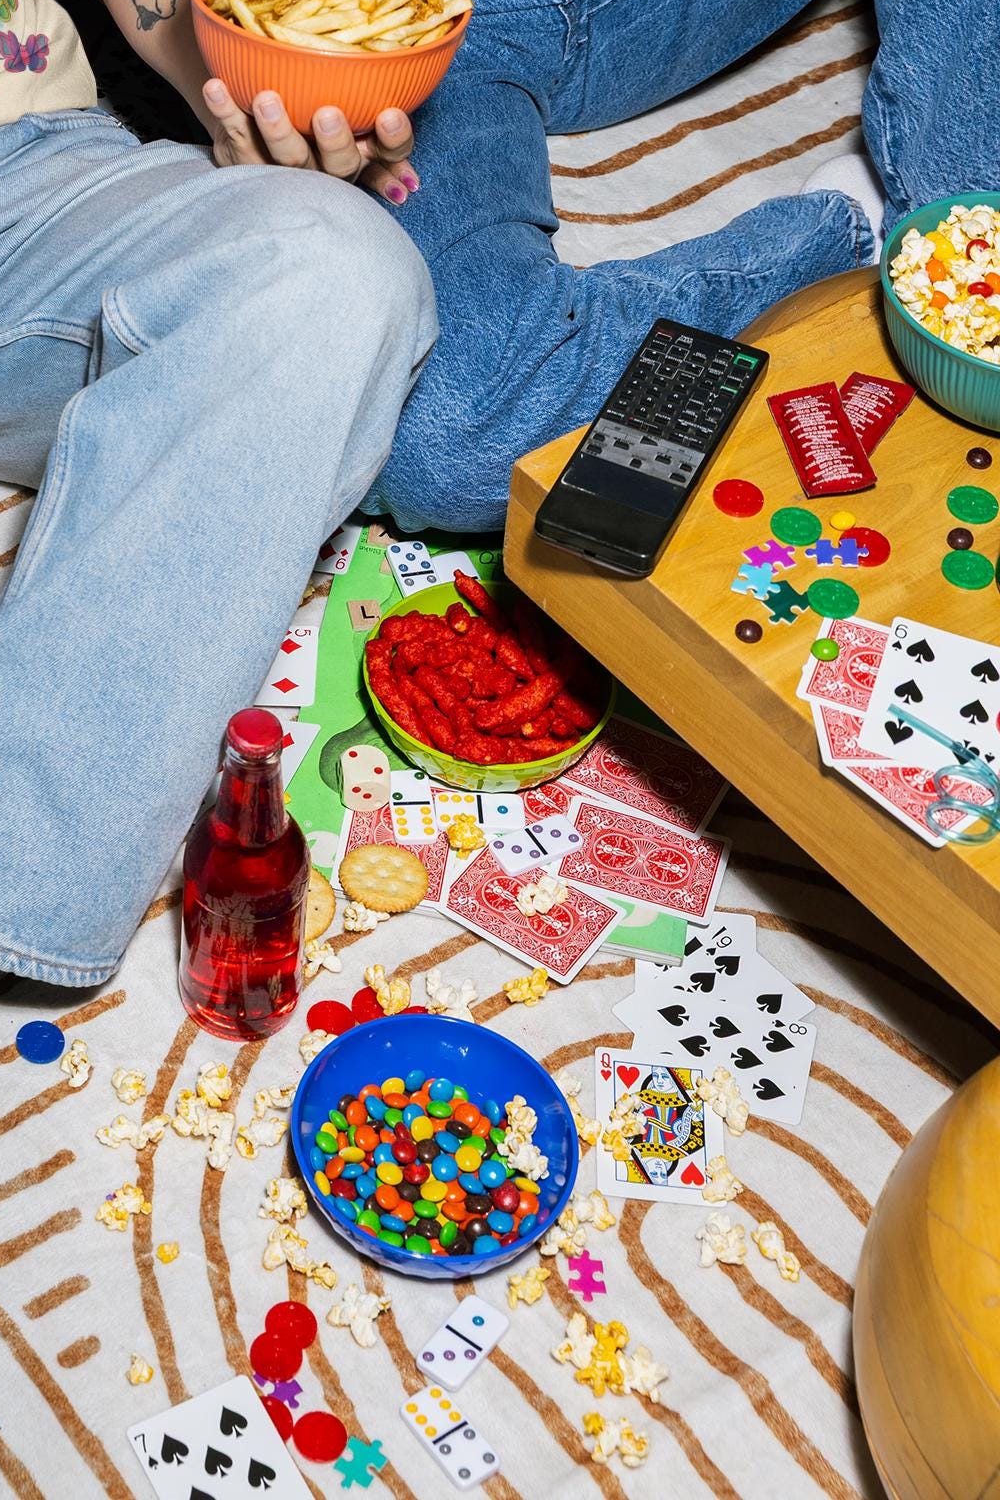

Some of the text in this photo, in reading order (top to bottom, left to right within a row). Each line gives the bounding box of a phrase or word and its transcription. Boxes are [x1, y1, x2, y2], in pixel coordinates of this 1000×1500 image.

[894, 624, 909, 640] 6
[788, 1023, 808, 1036] 8
[600, 1053, 612, 1069] Q
[134, 1434, 147, 1453] 7
